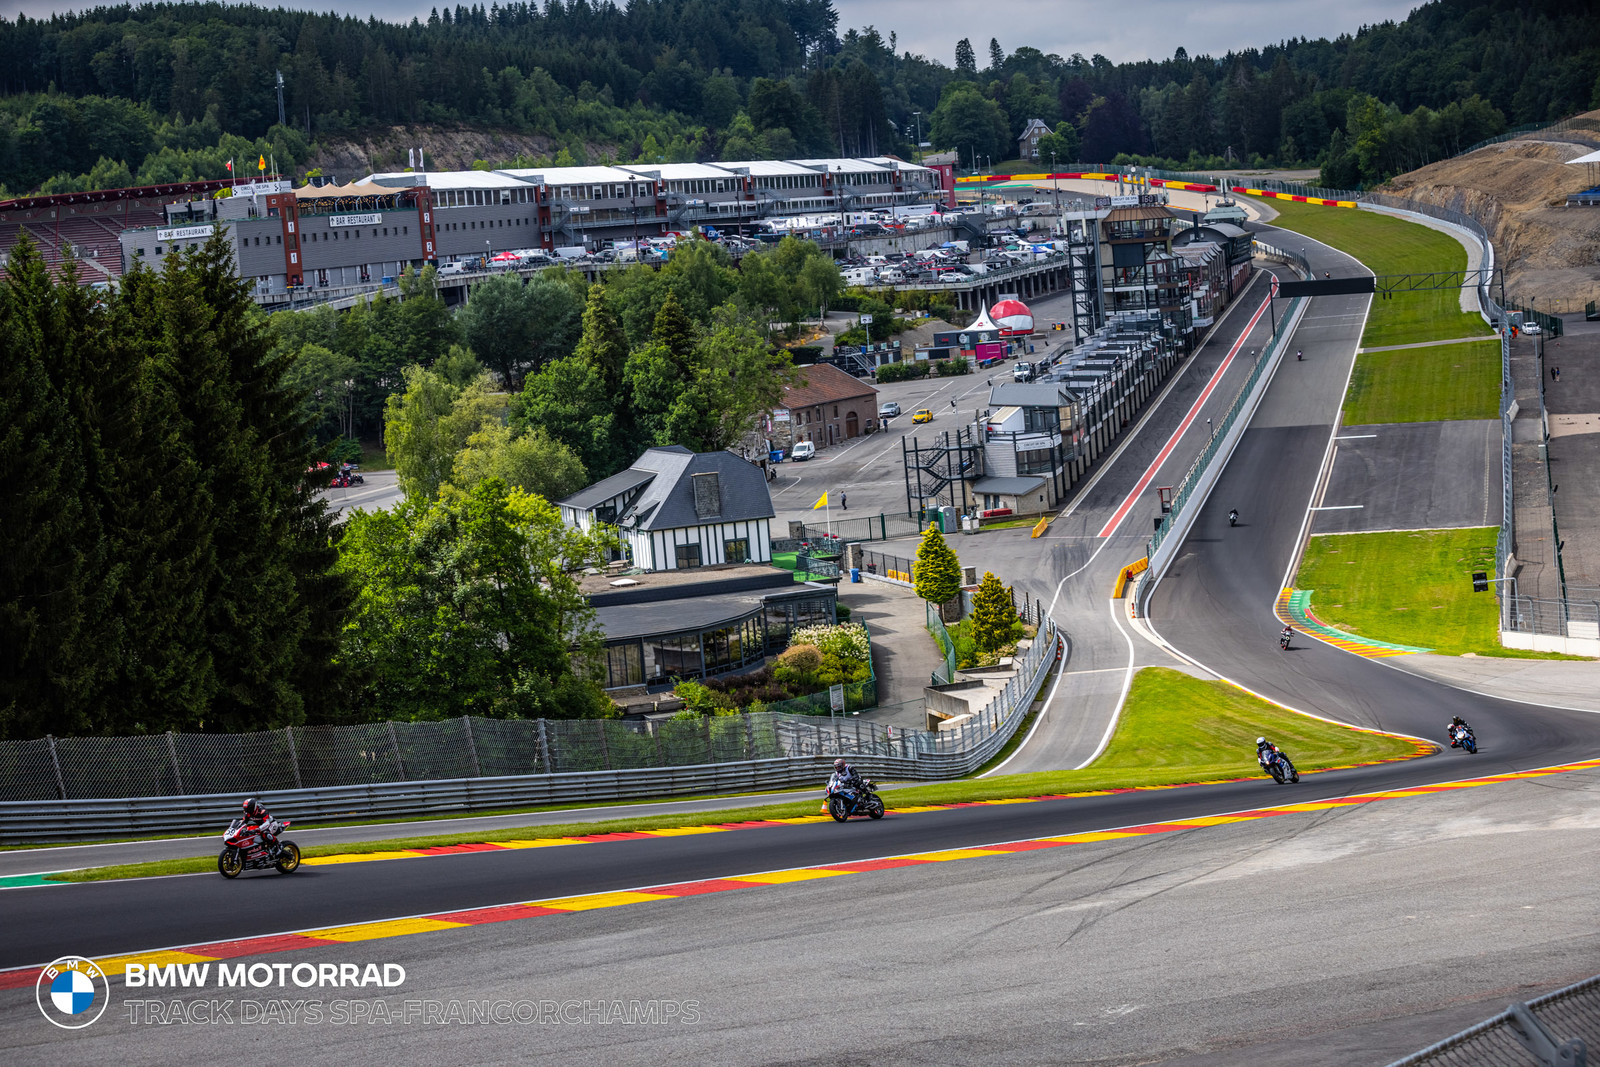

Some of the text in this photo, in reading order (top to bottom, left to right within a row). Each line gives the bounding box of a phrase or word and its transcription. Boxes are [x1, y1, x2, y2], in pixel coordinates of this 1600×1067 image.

[336, 215, 375, 225] BAR RESTAURANT
[176, 227, 207, 237] RESTAURANT
